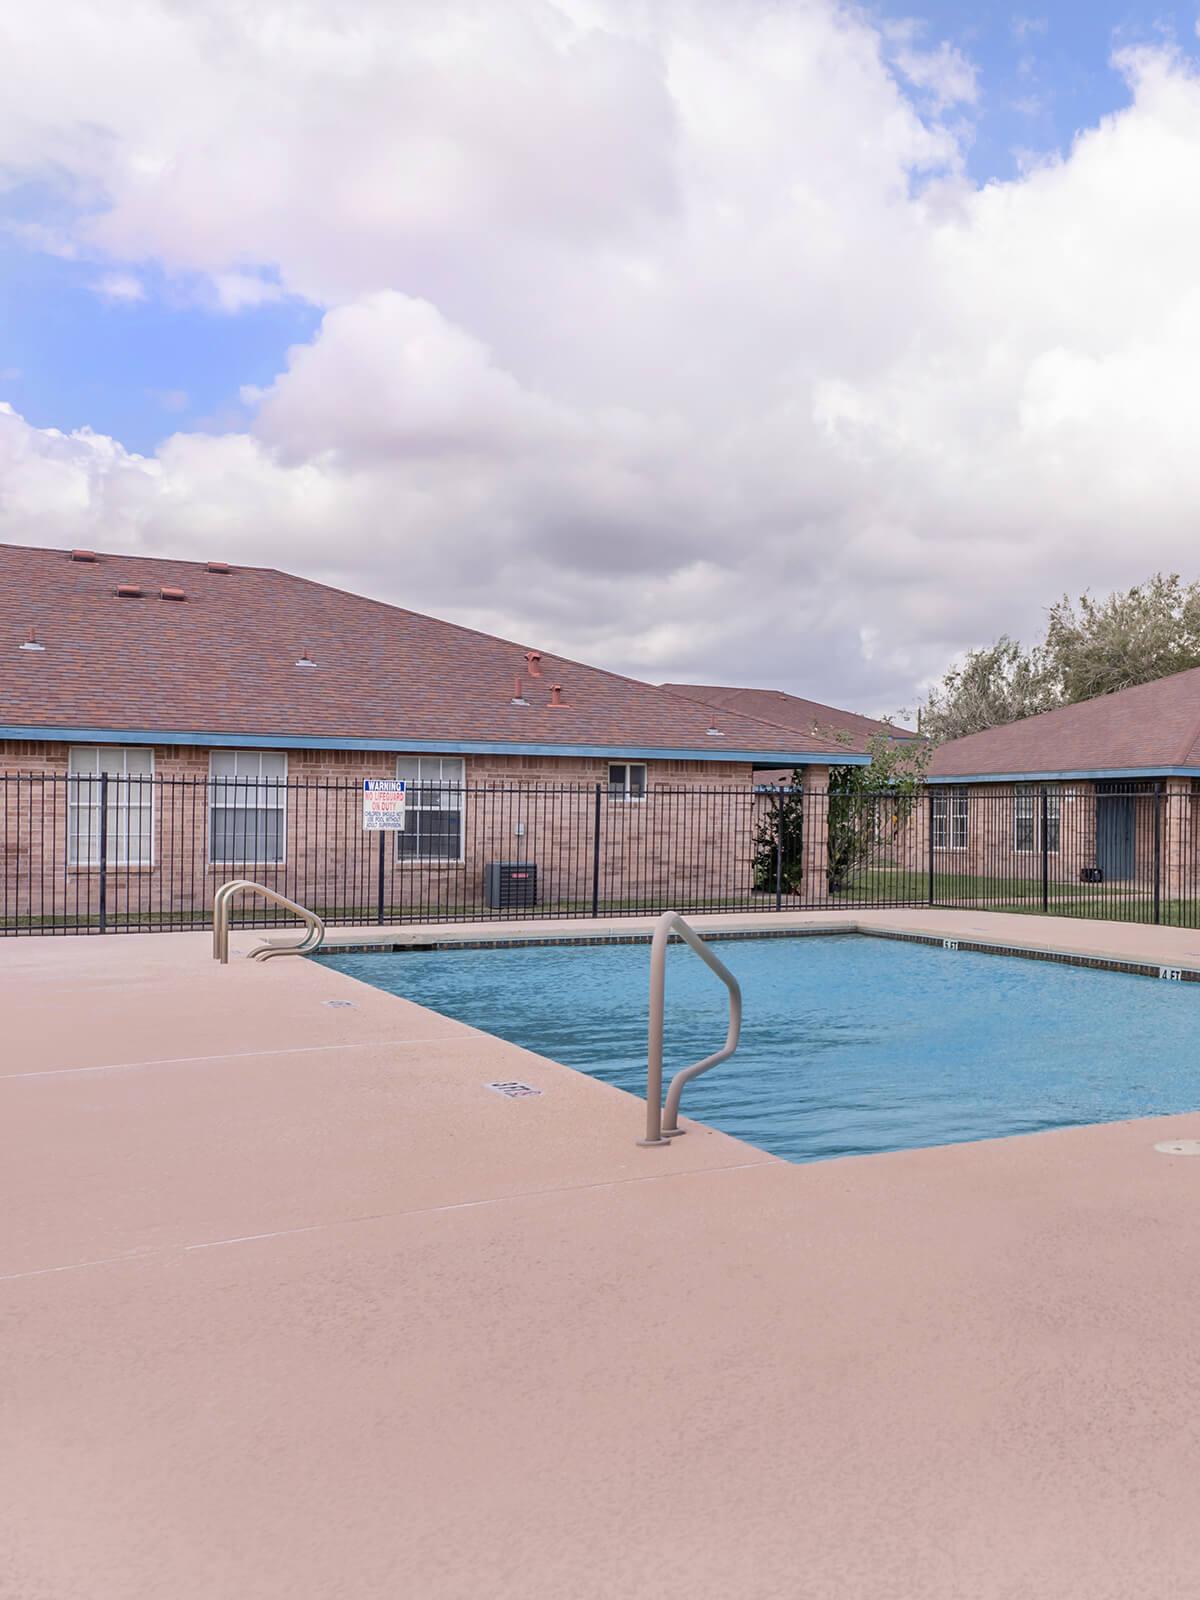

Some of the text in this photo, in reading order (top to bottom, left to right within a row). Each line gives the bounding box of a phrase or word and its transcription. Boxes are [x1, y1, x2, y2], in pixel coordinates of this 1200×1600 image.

[368, 781, 401, 791] WARNING
[364, 792, 404, 801] NO LIFEGUARD
[371, 801, 396, 811] ON DUTY
[1161, 969, 1180, 981] 4 FT
